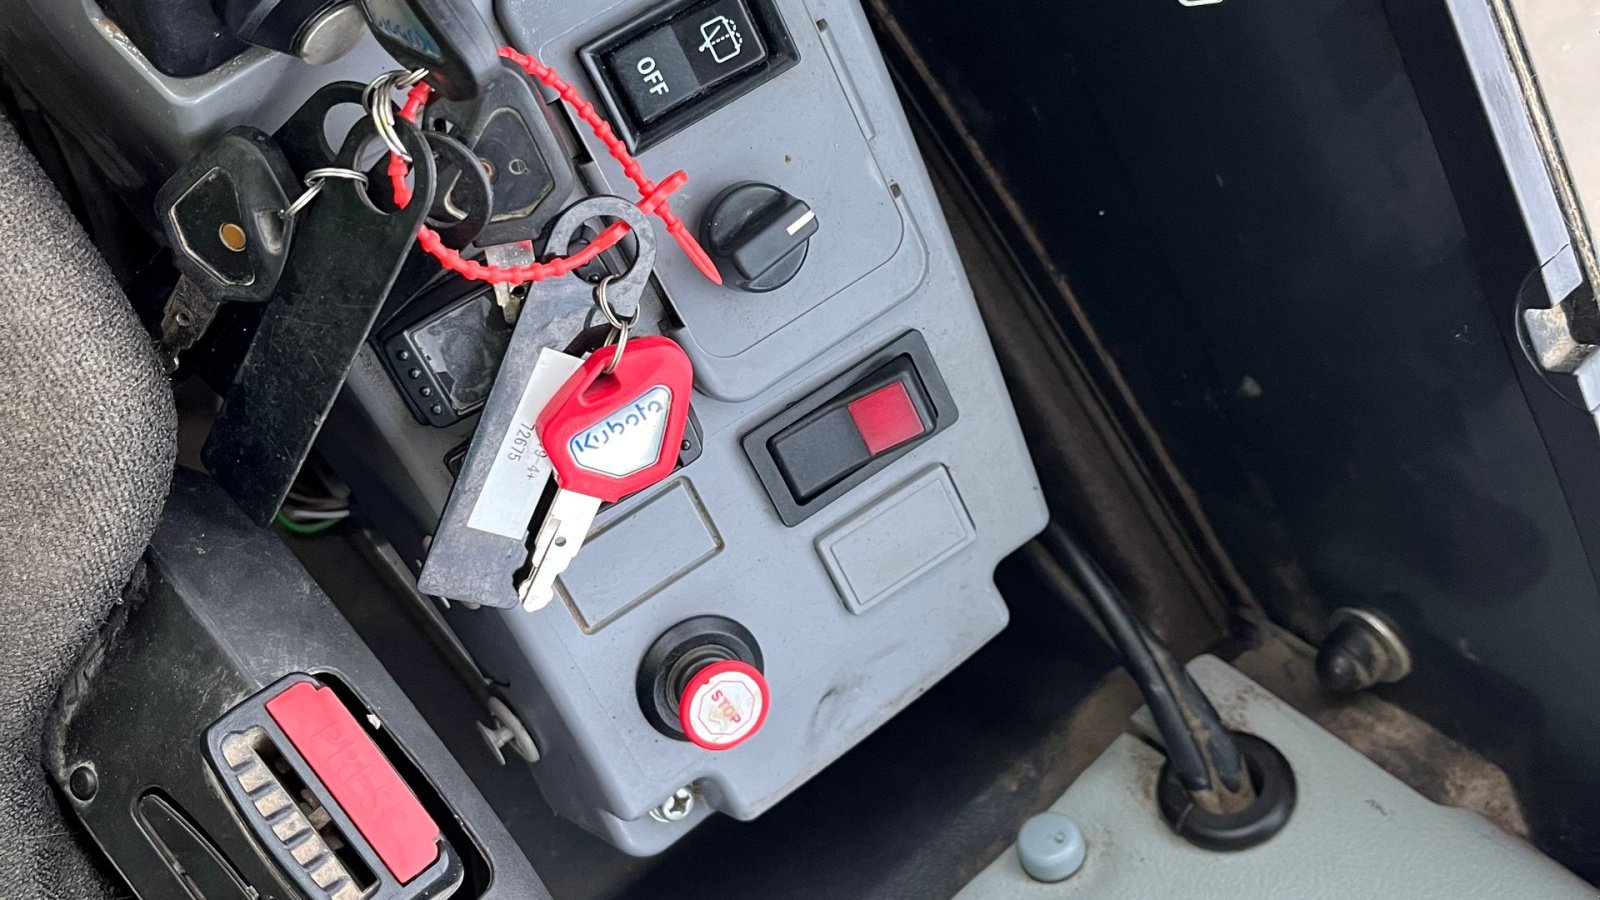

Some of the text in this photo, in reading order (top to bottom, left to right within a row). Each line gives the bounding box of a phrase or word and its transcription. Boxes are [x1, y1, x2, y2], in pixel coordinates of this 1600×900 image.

[637, 56, 669, 95] OFF
[507, 423, 536, 462] 72675
[574, 400, 664, 452] Kubota
[711, 690, 742, 723] STOP
